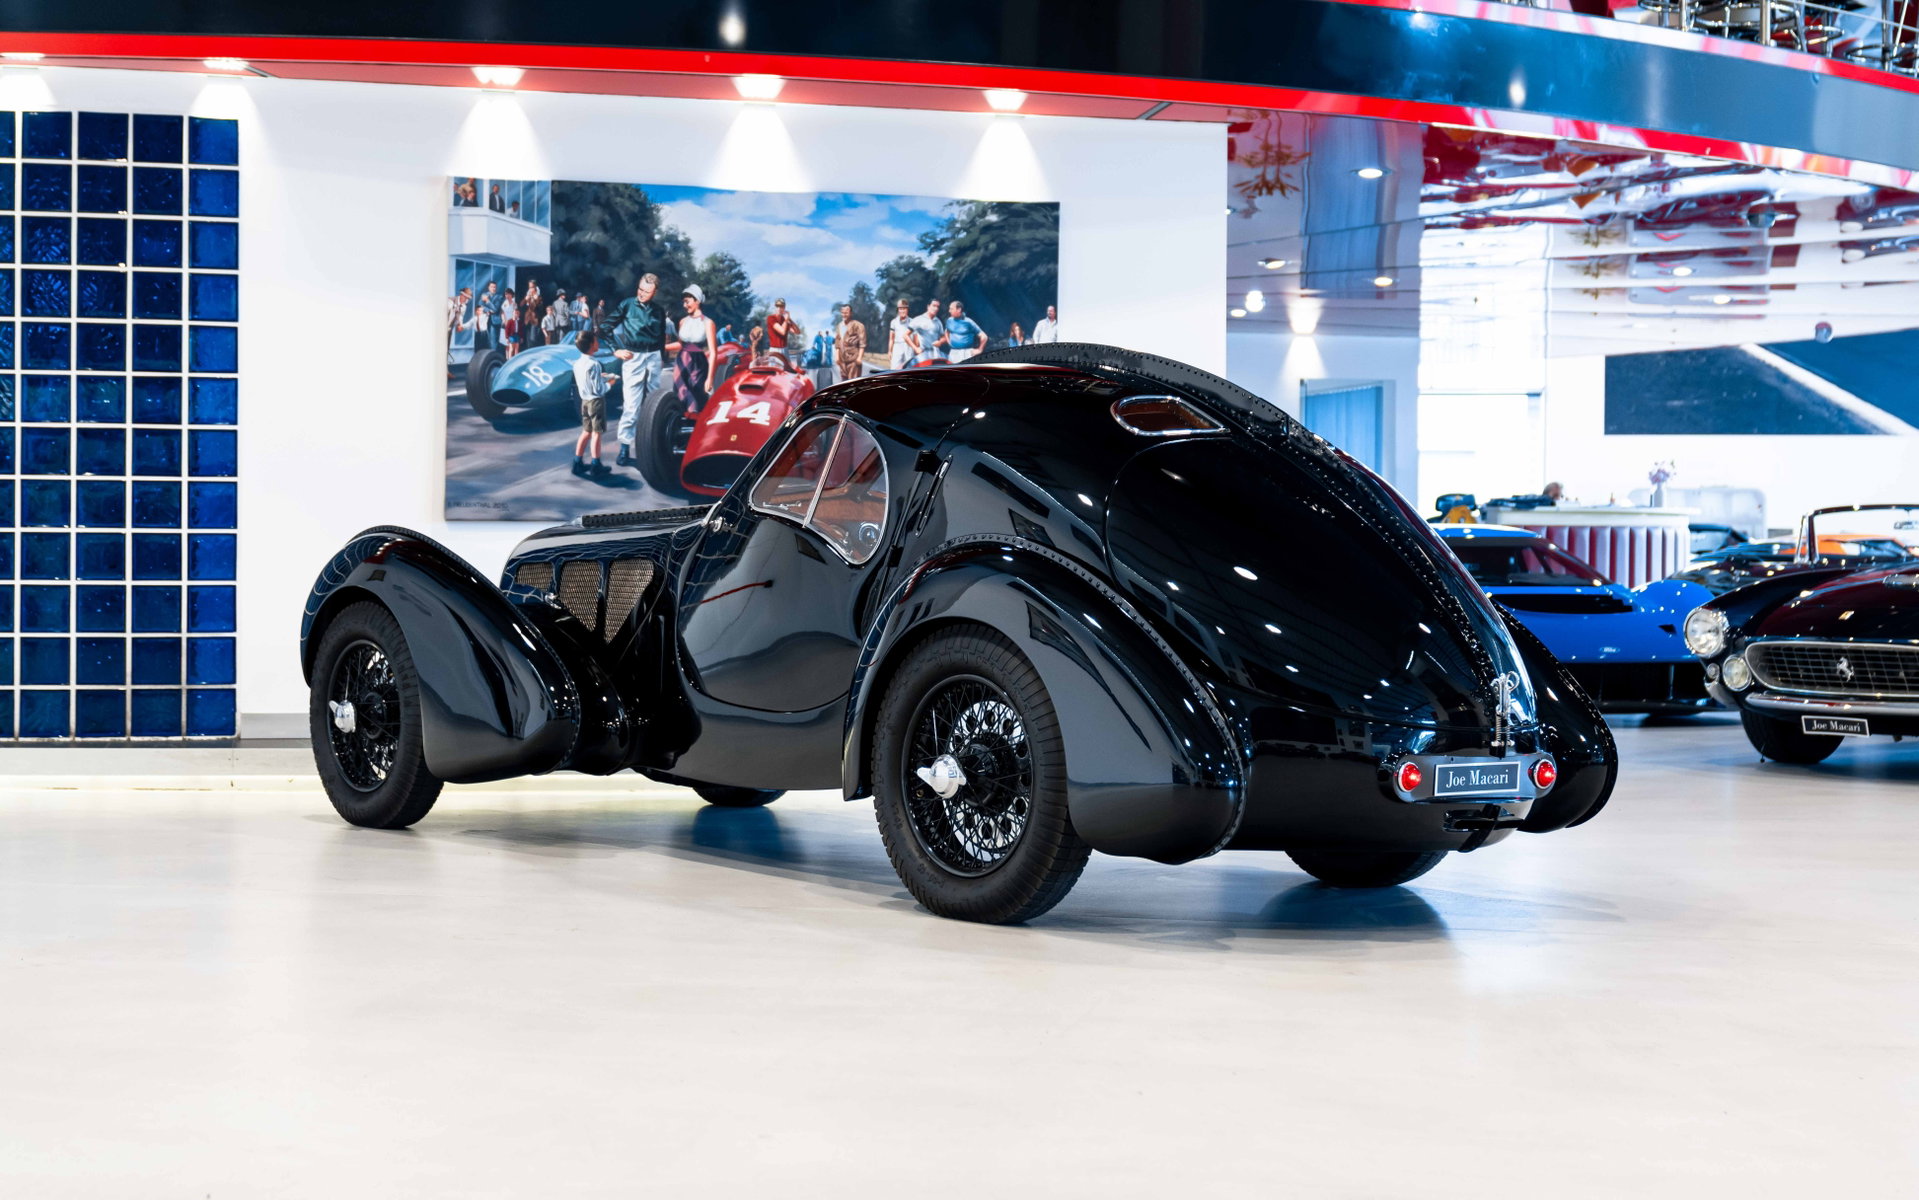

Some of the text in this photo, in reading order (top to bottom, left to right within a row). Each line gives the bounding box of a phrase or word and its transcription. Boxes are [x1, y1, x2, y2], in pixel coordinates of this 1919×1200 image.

[521, 365, 553, 388] 18
[706, 399, 771, 427] 14
[1811, 719, 1861, 733] Joe Macari
[1445, 768, 1509, 789] Joe Macari
